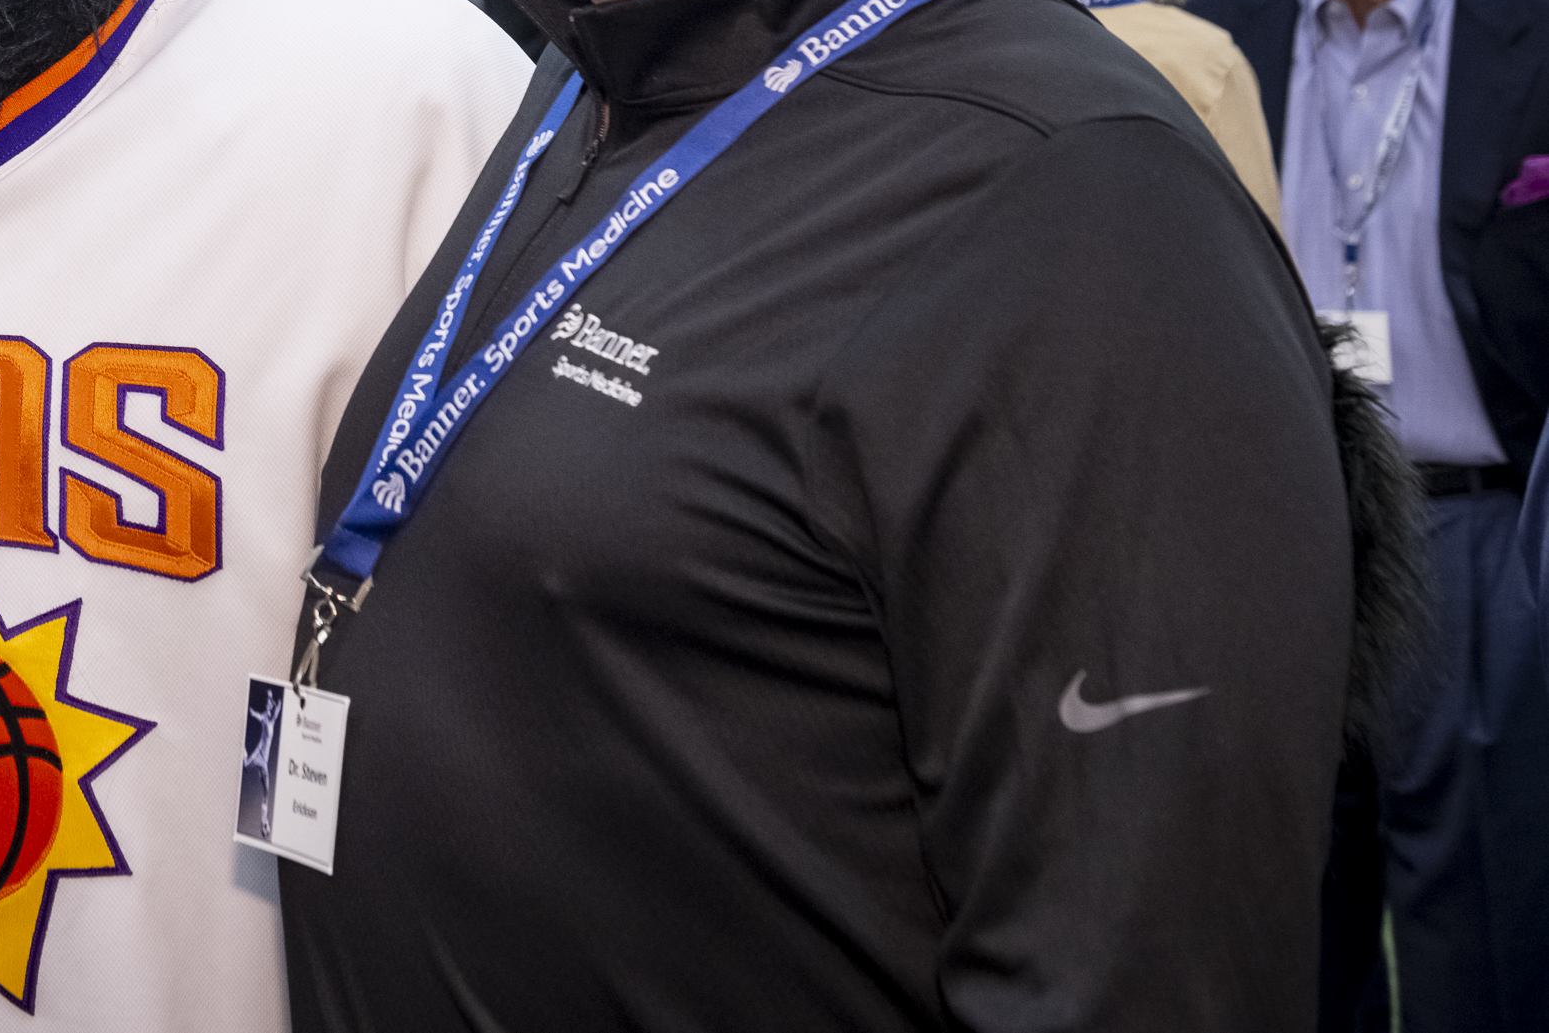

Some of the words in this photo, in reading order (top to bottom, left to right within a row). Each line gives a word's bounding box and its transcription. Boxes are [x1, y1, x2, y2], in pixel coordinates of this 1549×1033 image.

[483, 279, 565, 374] Sports
[560, 168, 680, 282] Medicine
[418, 273, 474, 368] Sports
[570, 313, 660, 376] Banner
[288, 757, 300, 778] Dr.
[301, 761, 328, 787] Steven
